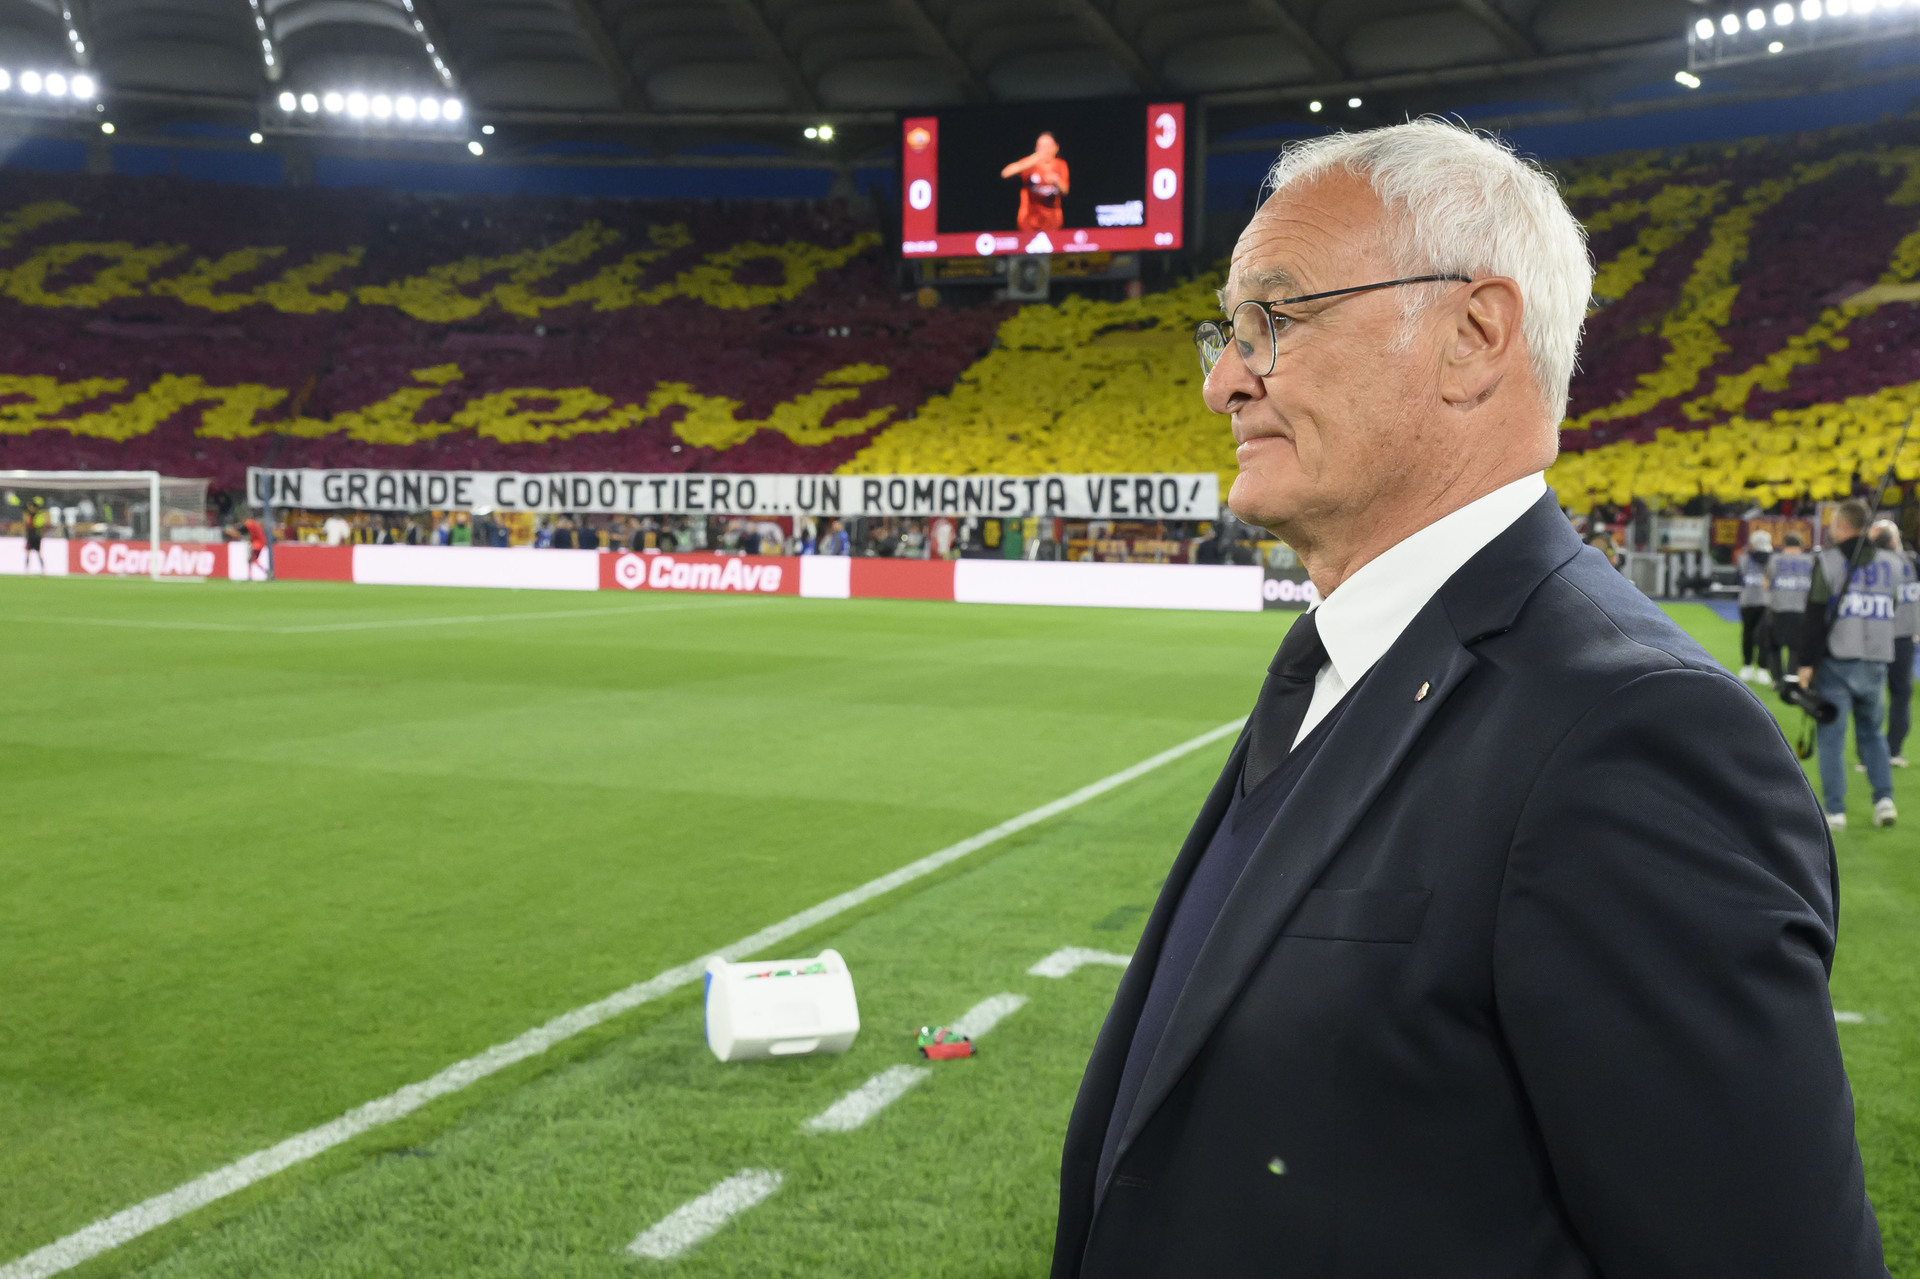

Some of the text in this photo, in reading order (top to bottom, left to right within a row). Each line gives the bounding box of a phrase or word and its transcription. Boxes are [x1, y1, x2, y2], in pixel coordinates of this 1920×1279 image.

[909, 179, 932, 210] 0
[1152, 167, 1177, 200] 0
[254, 473, 302, 502] UN
[323, 473, 473, 507] GRANDE
[863, 478, 1066, 512] ROMANISTA
[1087, 478, 1201, 514] VERO!
[107, 542, 216, 577] ComAve
[649, 555, 783, 592] ComAve
